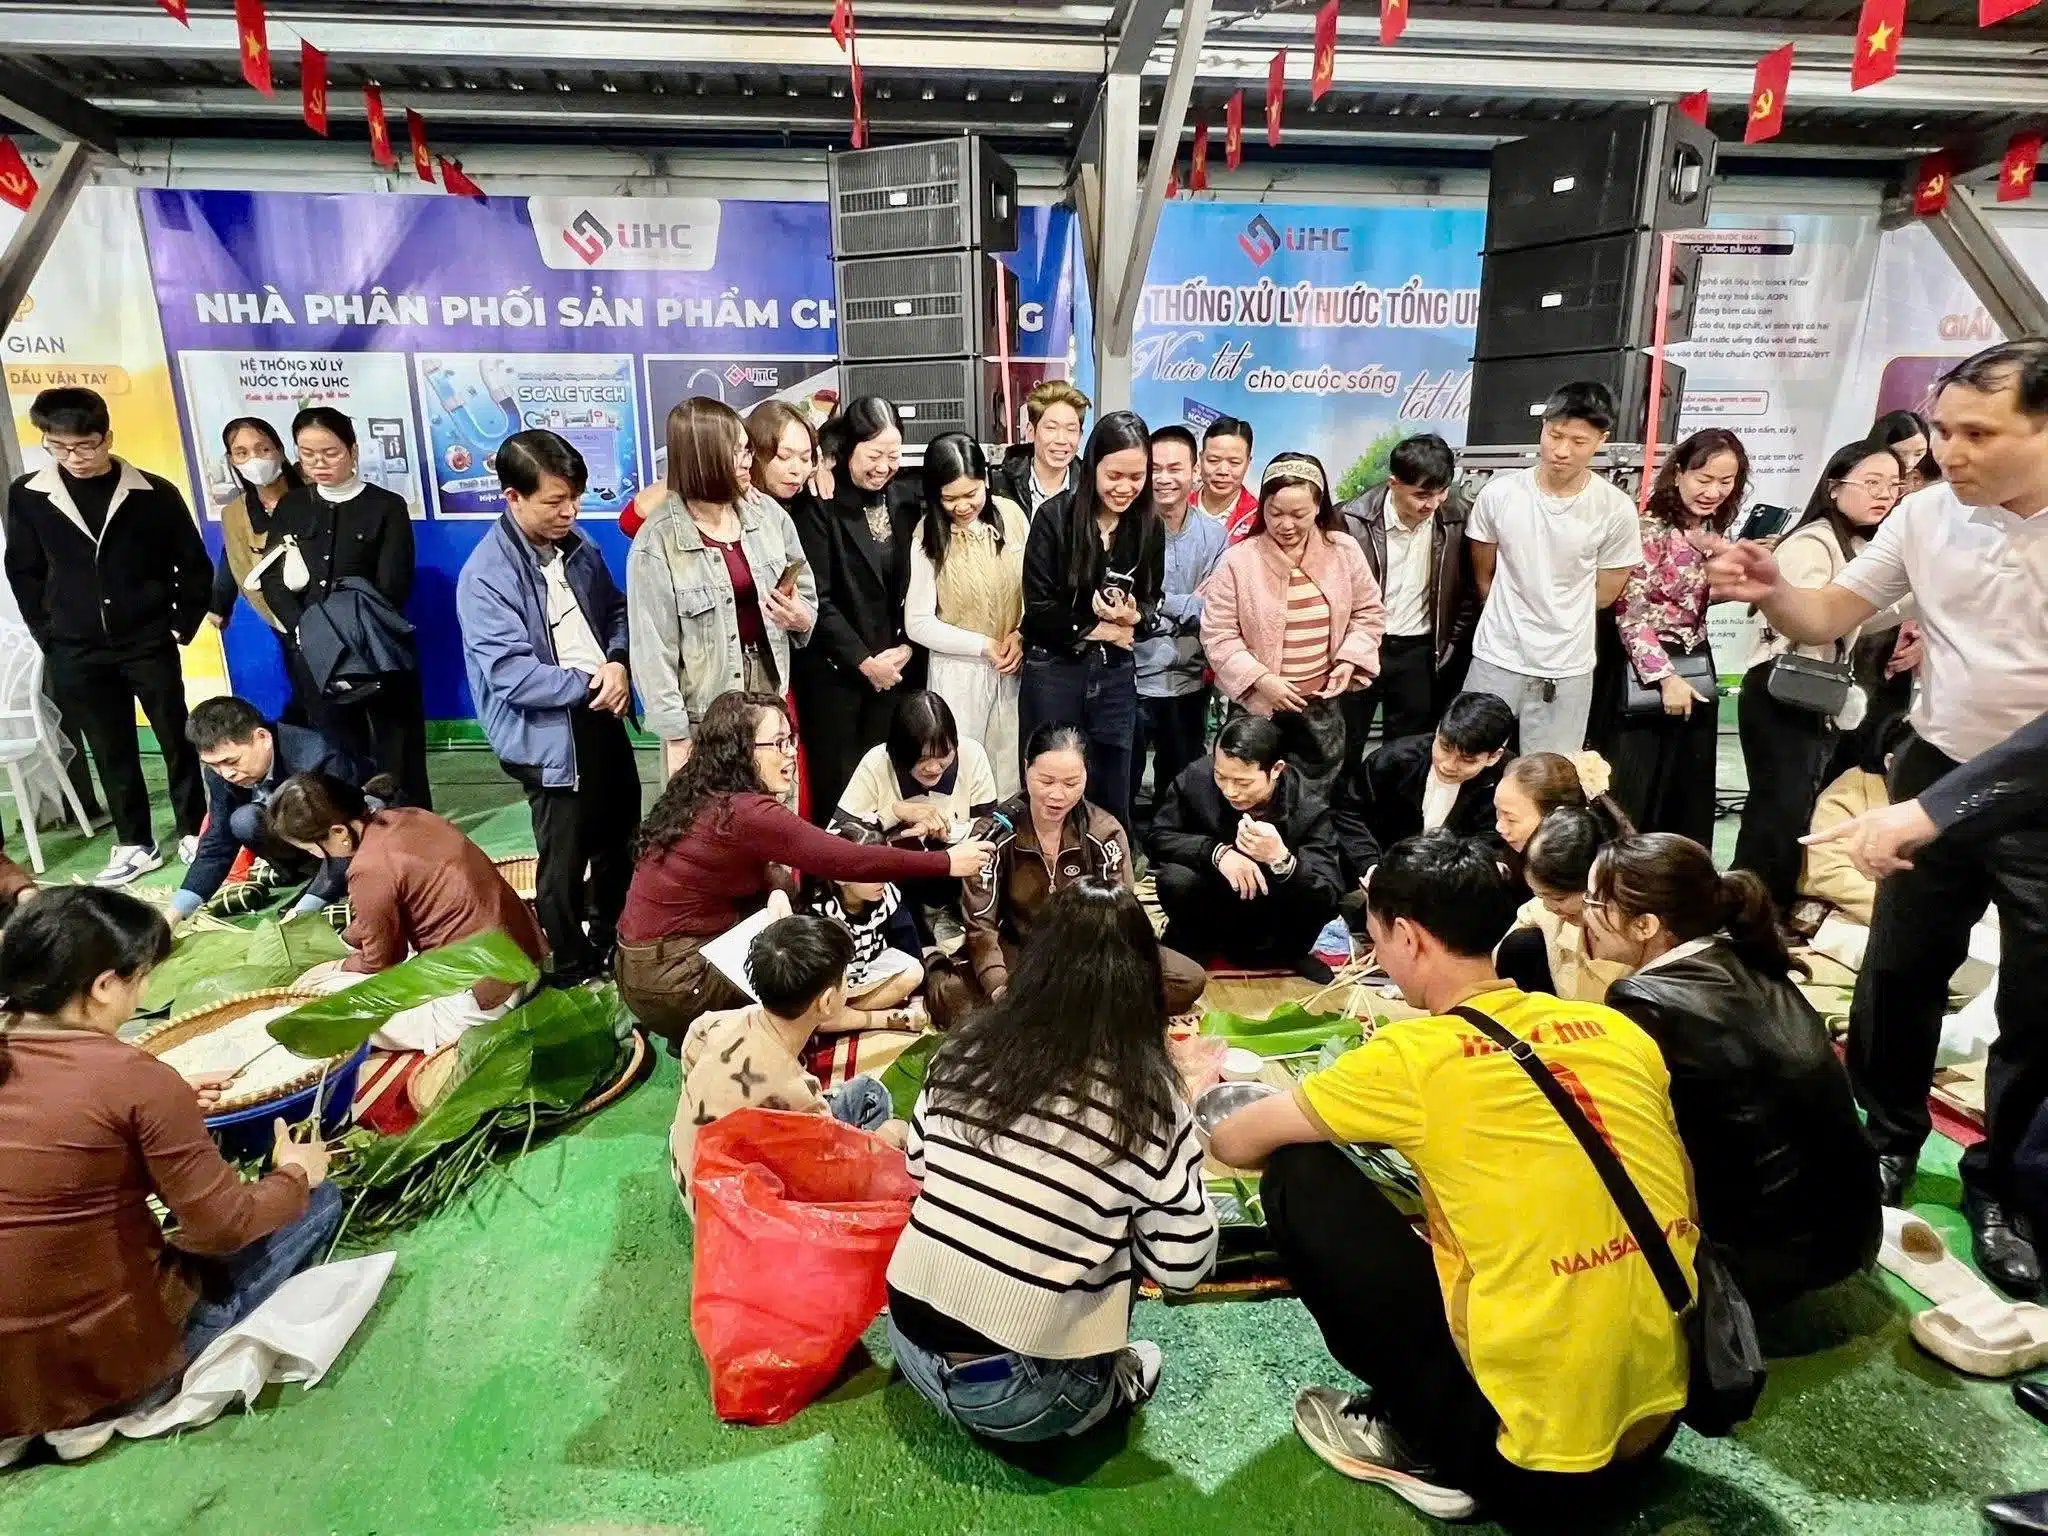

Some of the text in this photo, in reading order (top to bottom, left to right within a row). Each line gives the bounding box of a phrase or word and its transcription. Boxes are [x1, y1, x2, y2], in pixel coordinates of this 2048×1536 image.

[617, 223, 691, 249] UHC
[1285, 227, 1350, 251] UHC
[195, 285, 296, 325] NHÀ
[304, 286, 429, 326] PHÂN
[440, 286, 547, 328] PHỐI
[557, 285, 644, 328] SẢN
[657, 286, 779, 330] PHẨM
[1150, 279, 1231, 323] THỐNG
[1239, 279, 1274, 324] XỬ
[1280, 283, 1310, 323] LÝ
[1316, 284, 1380, 324] NƯỚC
[1386, 277, 1449, 325] TỔNG
[7, 336, 66, 353] GIAN
[240, 357, 343, 374] HỆ THỐNG XỬ LÝ
[81, 373, 108, 384] TAY
[240, 373, 278, 387] NƯỚC
[322, 377, 350, 388] UHC
[1247, 369, 1287, 389] cho
[1291, 367, 1341, 393] cuộc
[1346, 366, 1397, 394] sống
[579, 386, 627, 402] TECH
